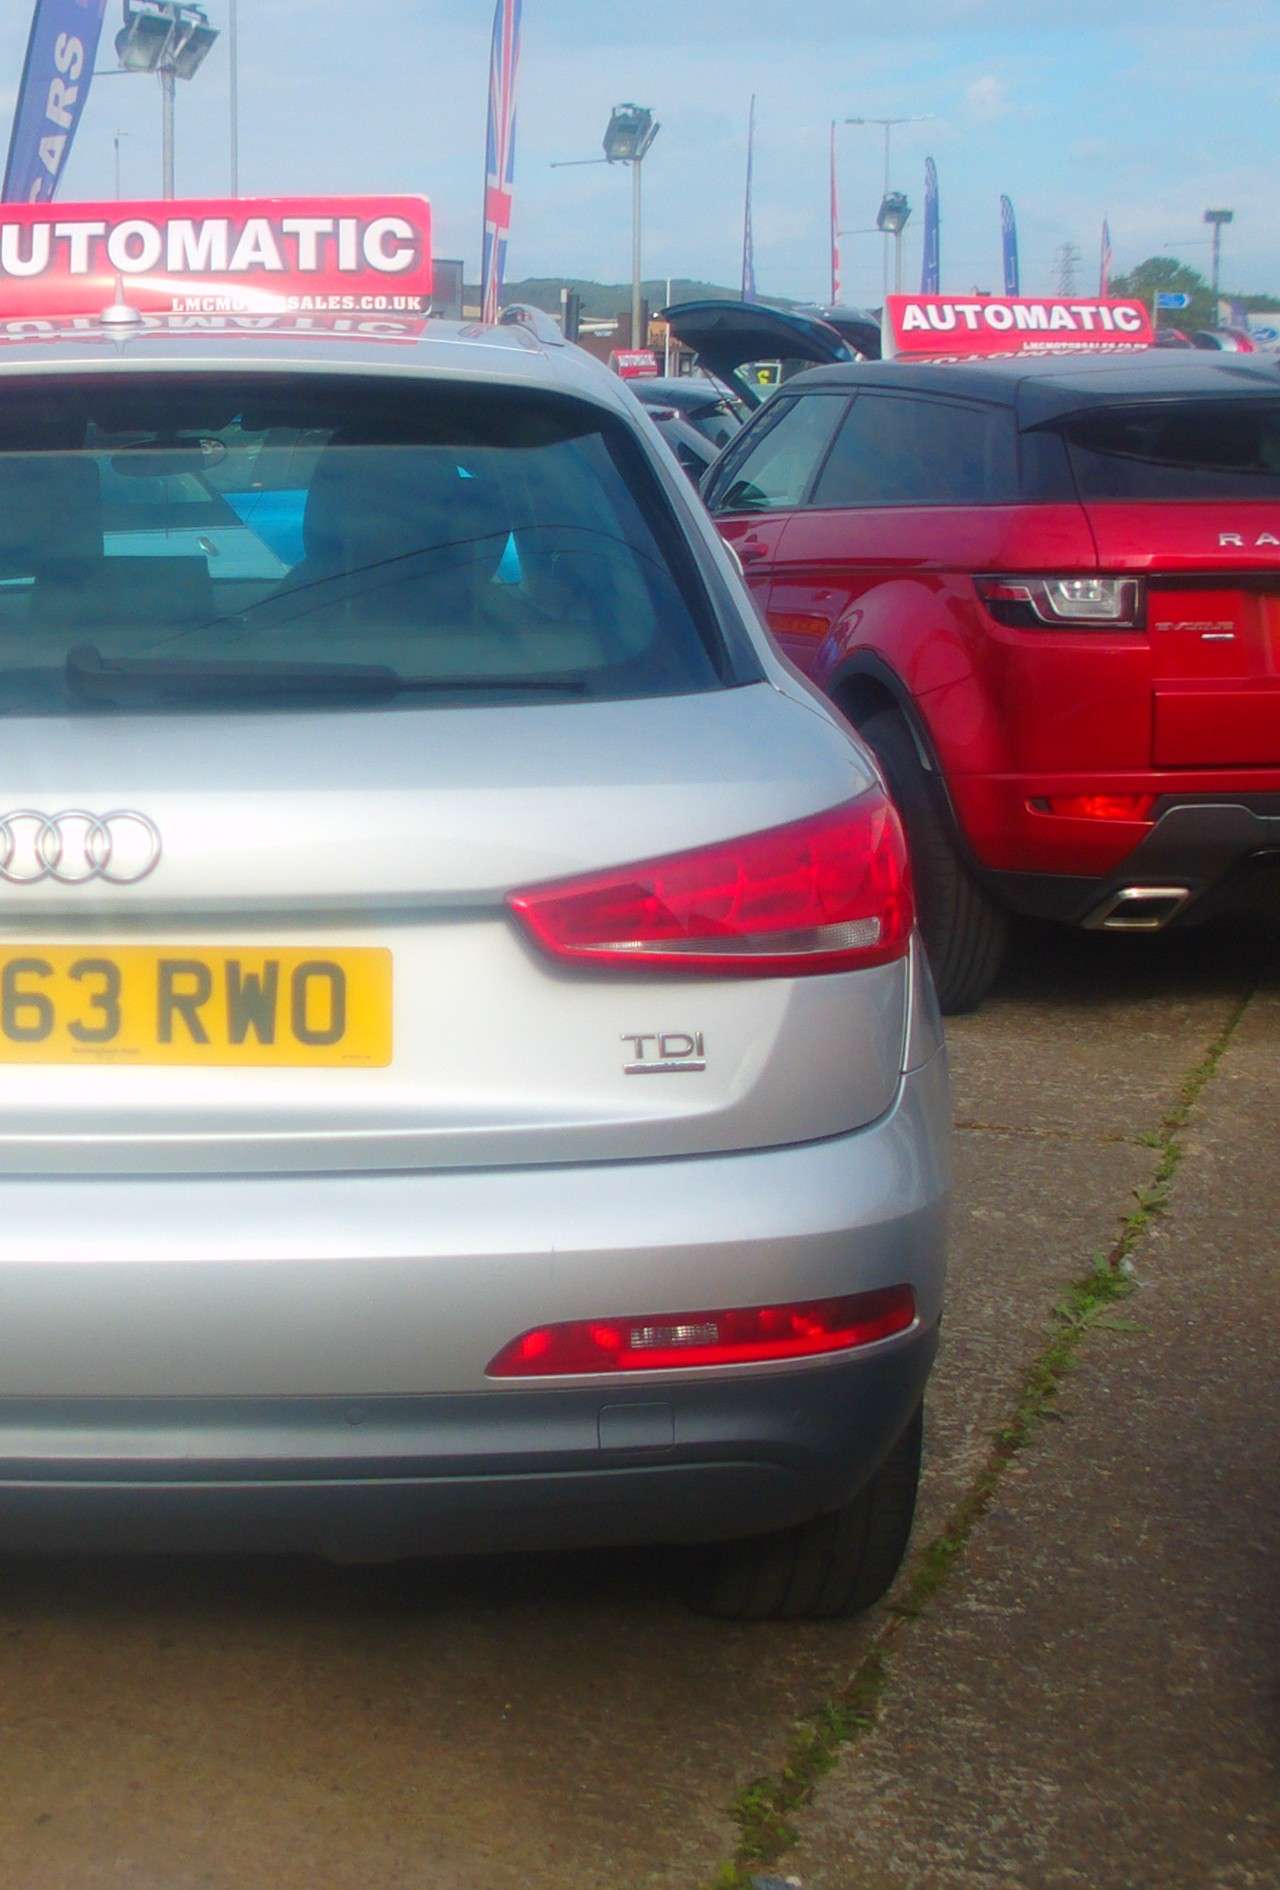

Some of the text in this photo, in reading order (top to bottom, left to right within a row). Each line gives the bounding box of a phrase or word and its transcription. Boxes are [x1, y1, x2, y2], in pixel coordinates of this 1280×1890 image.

[172, 295, 421, 312] LMCMOSALES.CO.UK
[902, 304, 1142, 331] AUTOMATIC
[157, 959, 346, 1046] RWO
[621, 1032, 704, 1059] TDI
